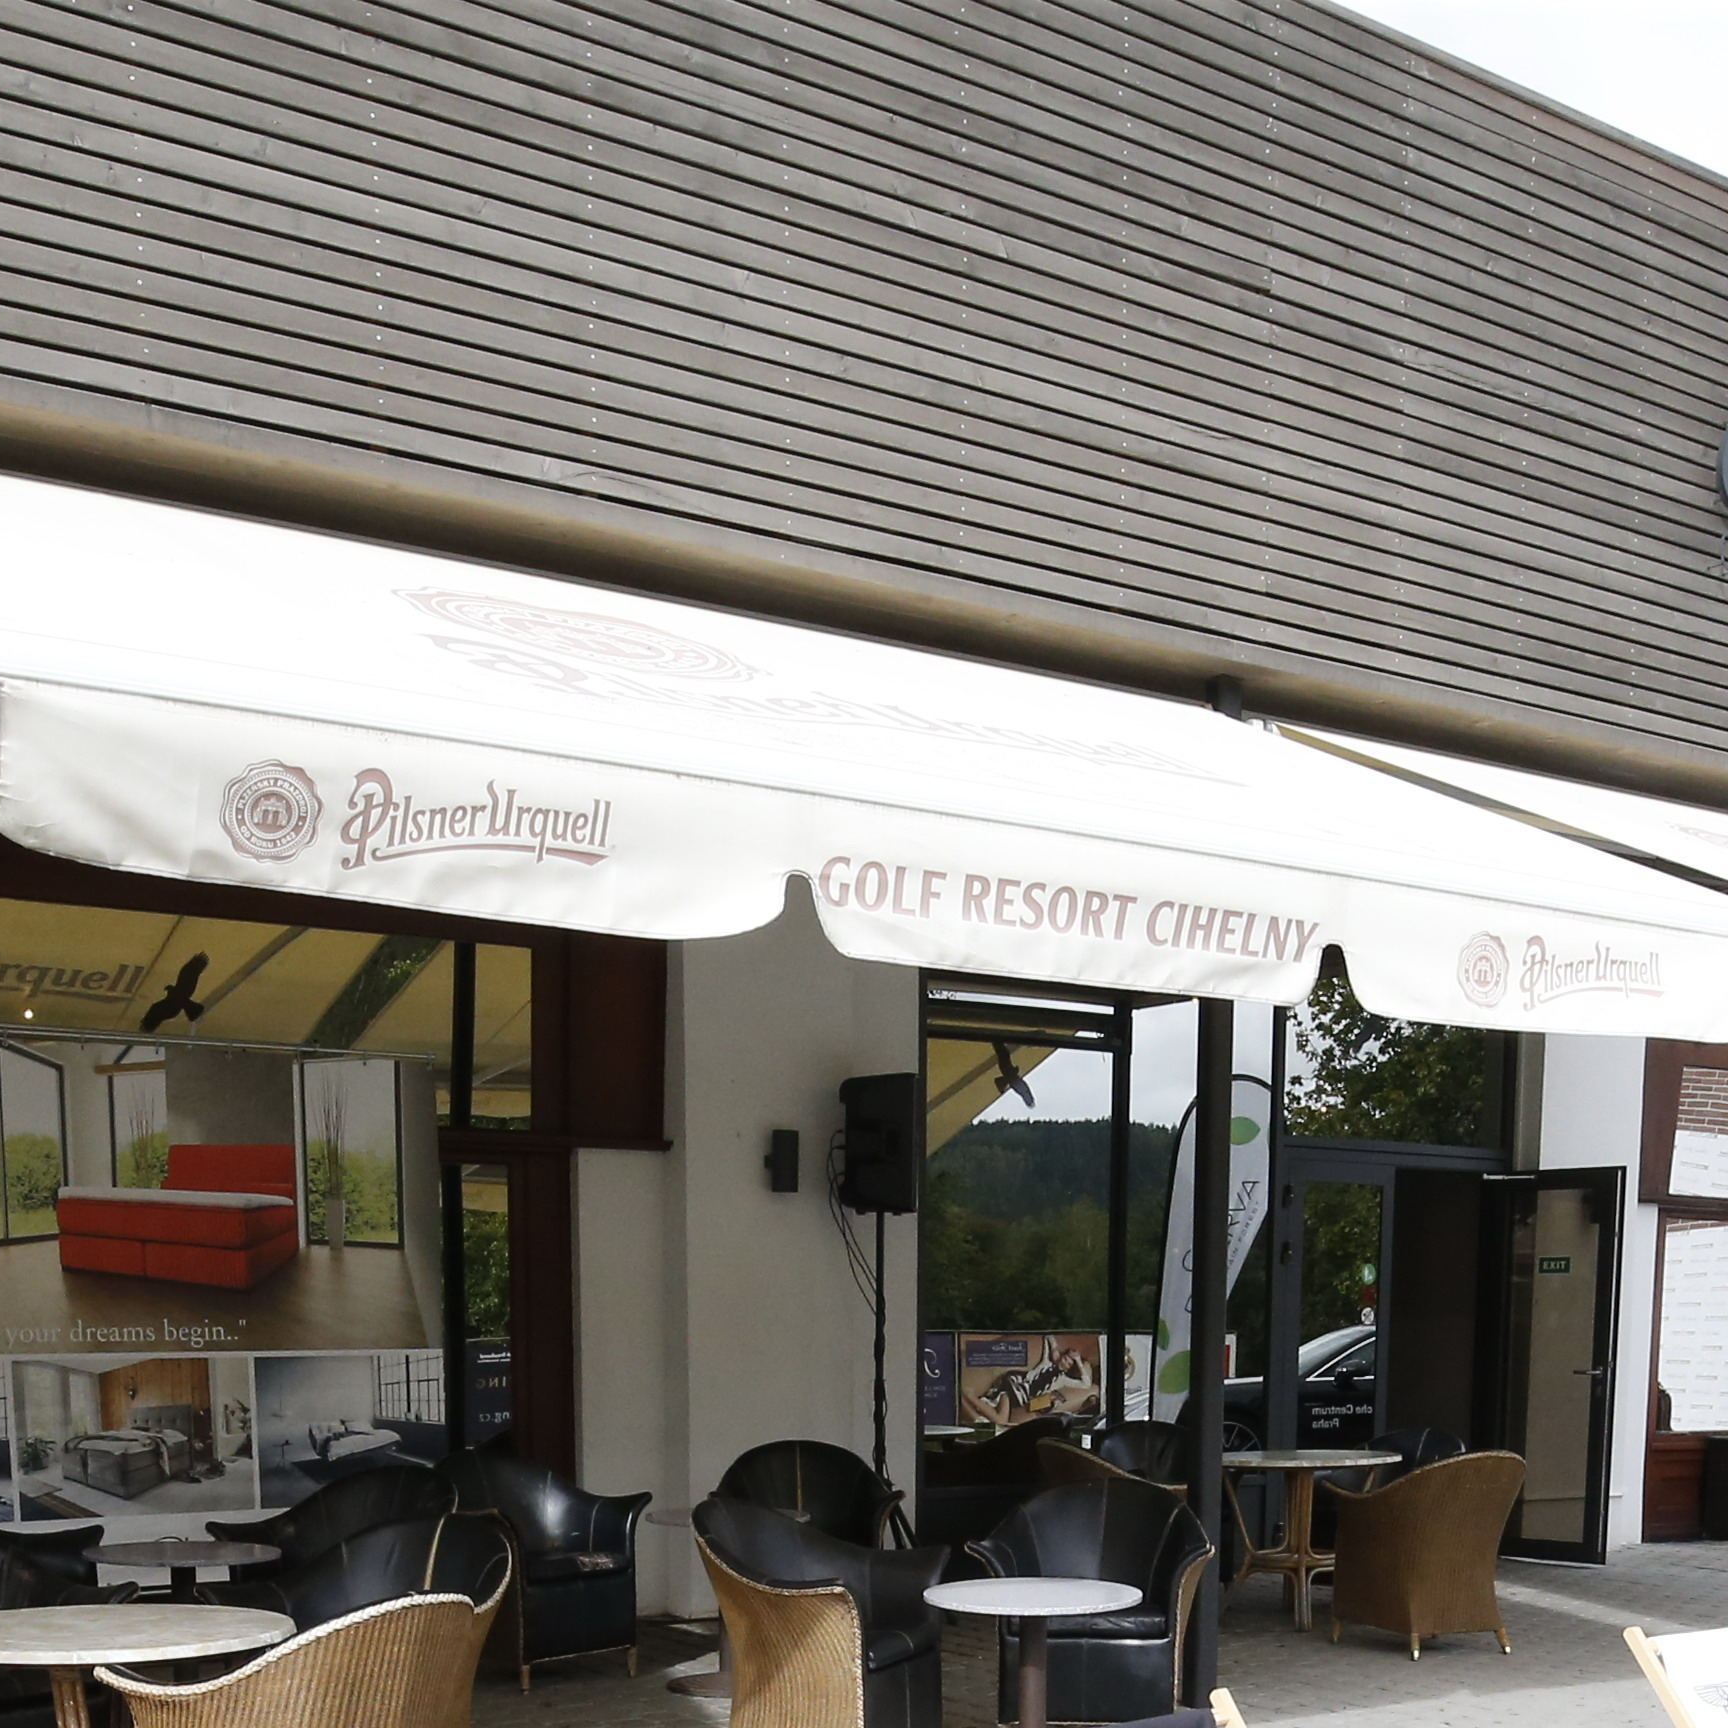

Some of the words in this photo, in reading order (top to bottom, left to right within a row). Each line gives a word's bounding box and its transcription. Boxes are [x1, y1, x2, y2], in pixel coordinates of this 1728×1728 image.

[339, 768, 488, 871] Pilsner
[485, 778, 612, 864] Urquell
[819, 856, 949, 919] GOLF
[961, 873, 1138, 941] RESORT
[1146, 900, 1320, 963] CIHELNY
[1519, 935, 1595, 1011] Pilsner
[1594, 940, 1661, 999] Urquell
[1543, 1261, 1567, 1270] EXIT
[5, 1326, 60, 1346] your
[70, 1319, 155, 1342] dreams
